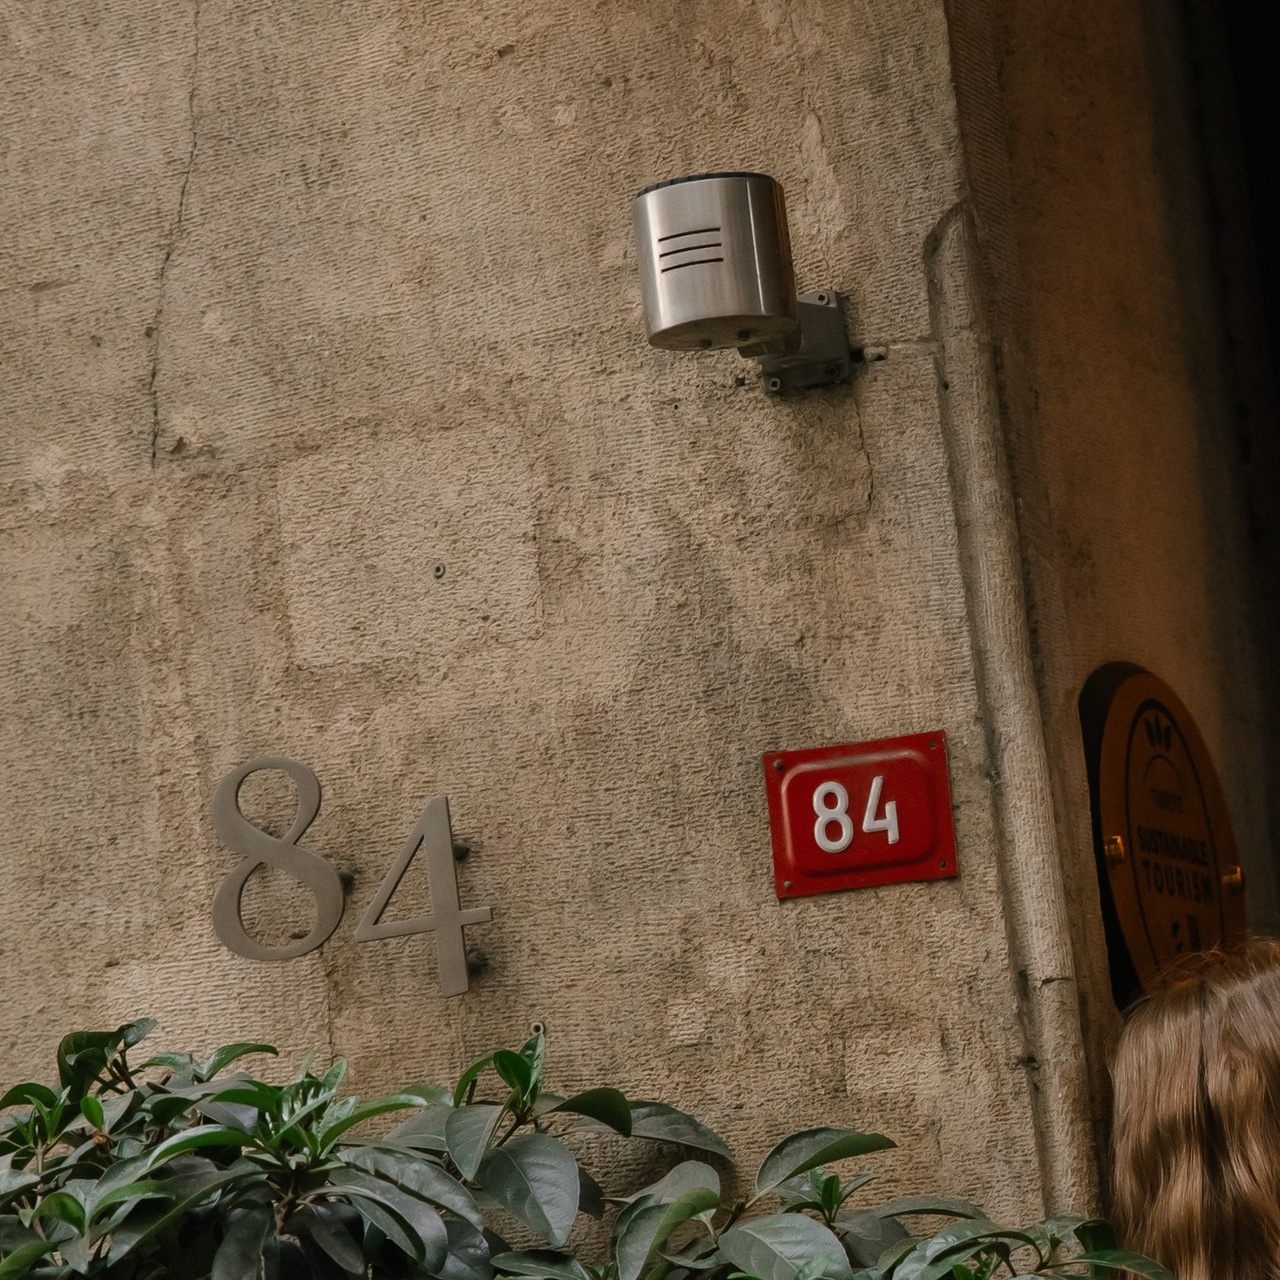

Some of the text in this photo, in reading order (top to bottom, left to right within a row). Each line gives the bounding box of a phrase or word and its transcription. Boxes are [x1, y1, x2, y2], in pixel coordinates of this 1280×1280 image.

[811, 775, 900, 855] 84
[1138, 825, 1208, 866] SUSTAINABLE
[211, 757, 493, 998] 84
[1142, 859, 1213, 903] TOURISM
